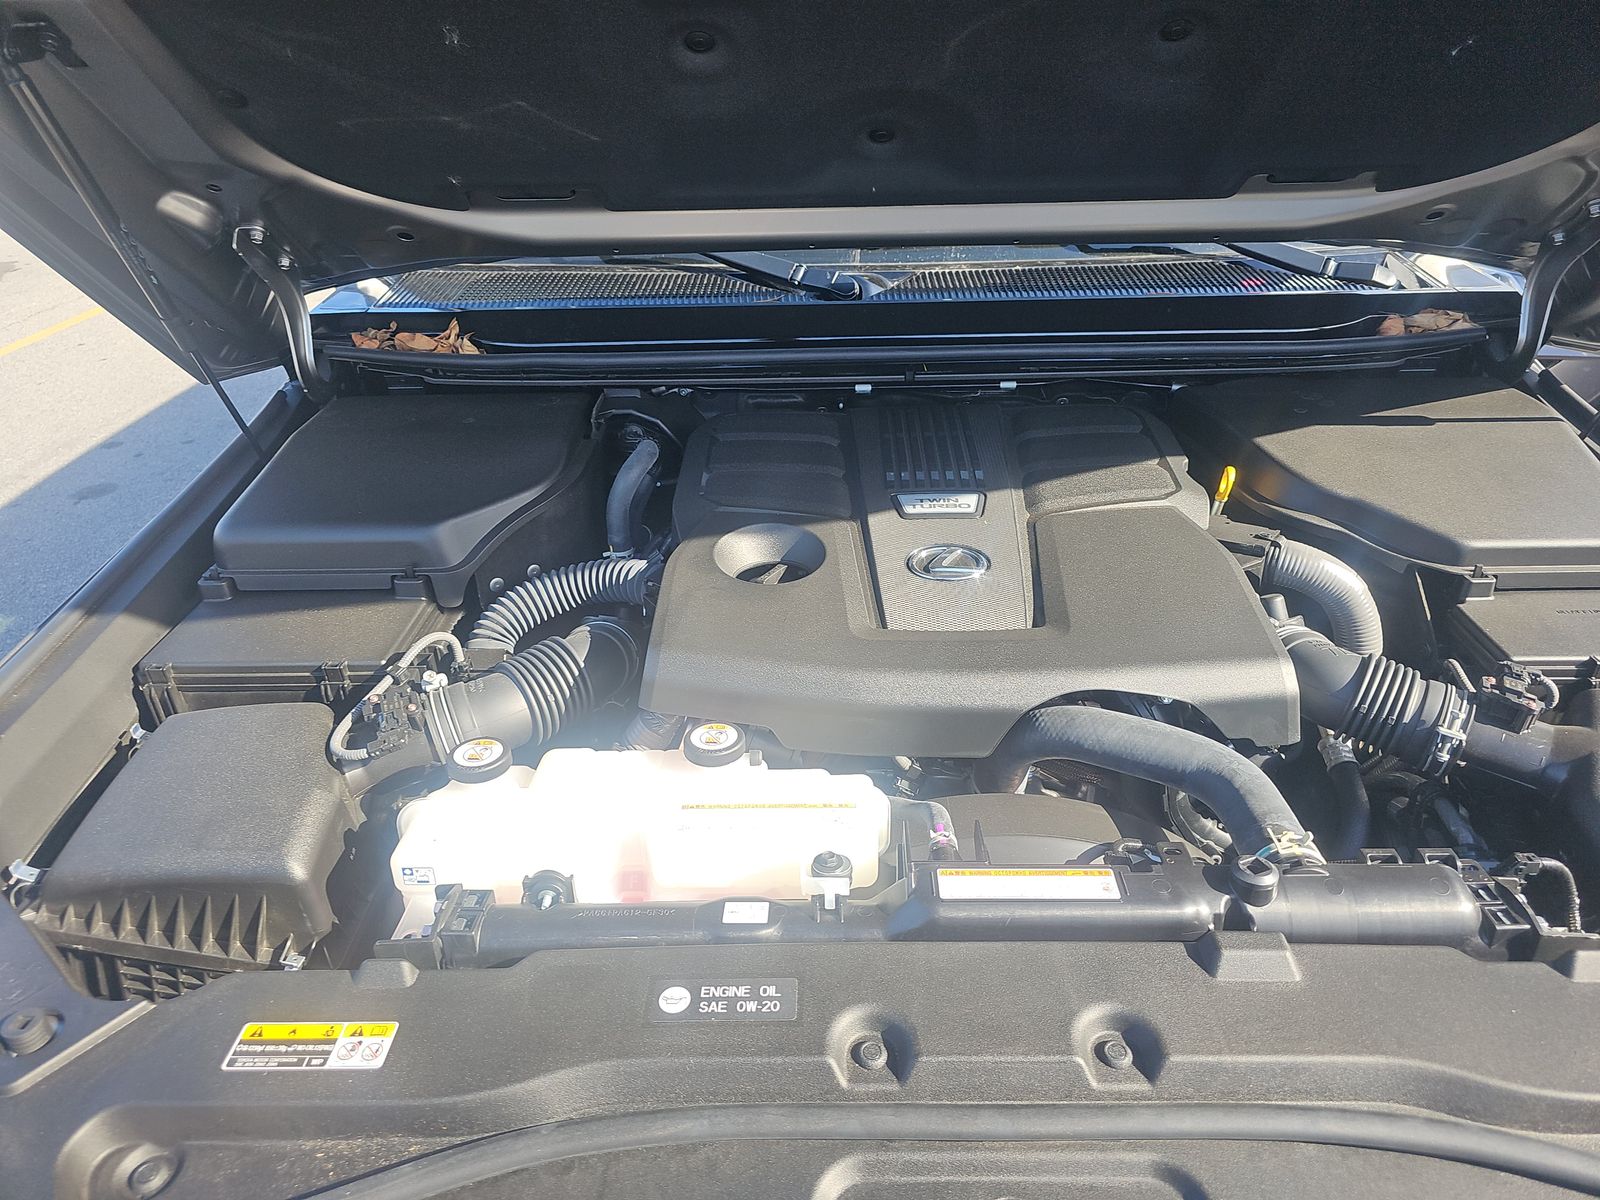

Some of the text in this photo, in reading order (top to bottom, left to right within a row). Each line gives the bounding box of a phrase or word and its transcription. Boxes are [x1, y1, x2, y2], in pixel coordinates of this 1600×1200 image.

[700, 985, 781, 998] ENGINE OIL
[699, 1000, 781, 1013] SAE 0W-20
